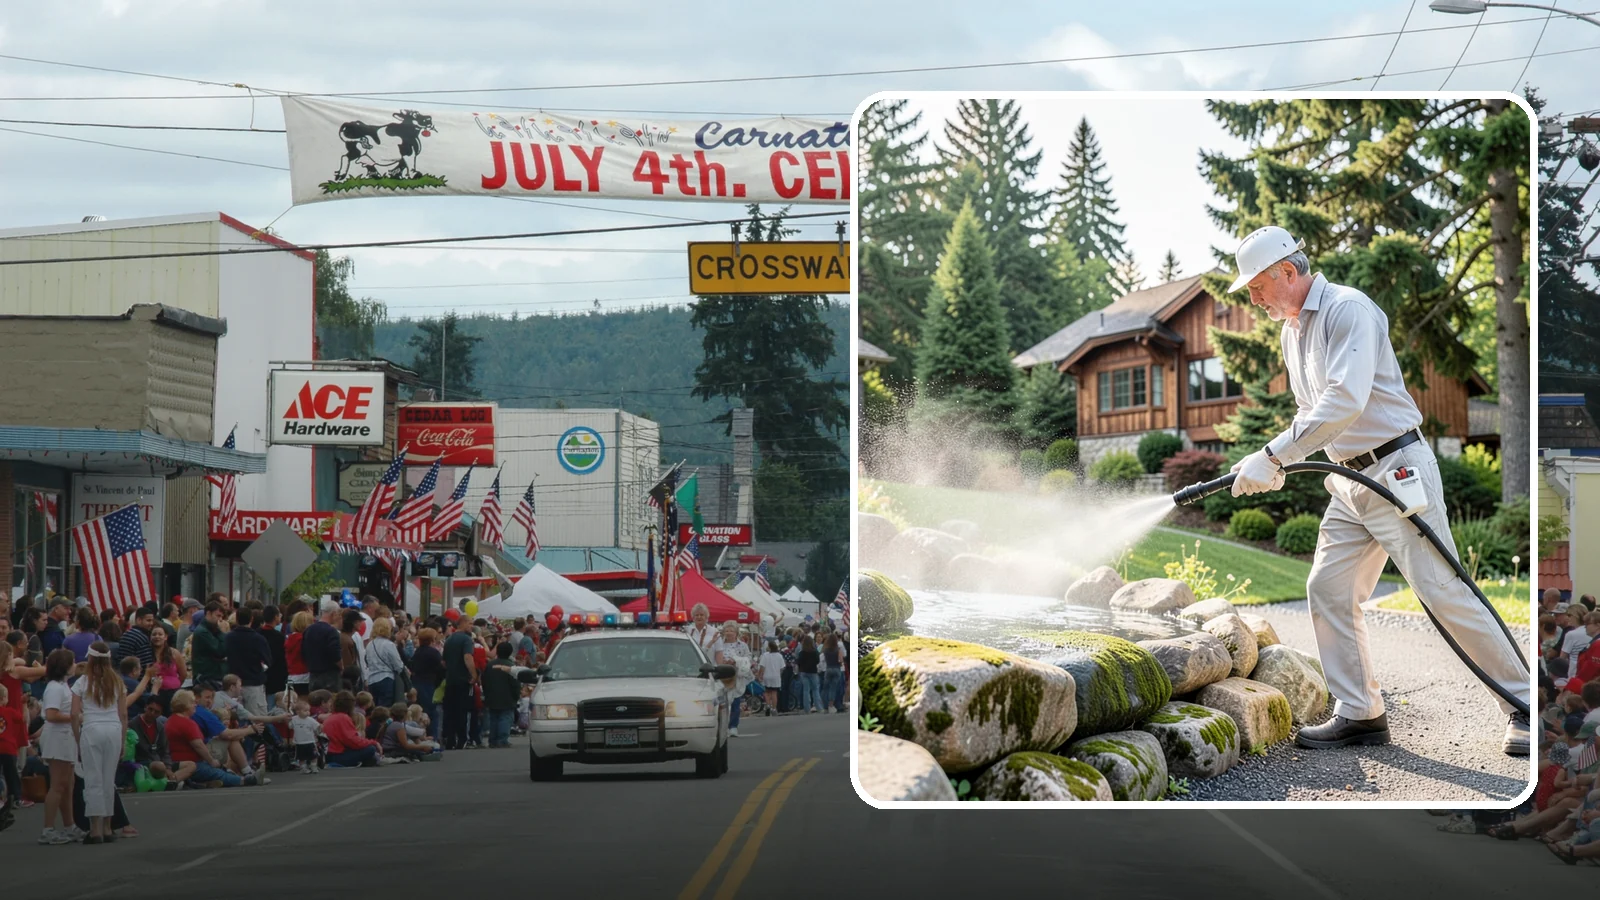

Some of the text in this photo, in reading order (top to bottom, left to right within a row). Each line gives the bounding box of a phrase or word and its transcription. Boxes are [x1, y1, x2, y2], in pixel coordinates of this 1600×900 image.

[481, 141, 605, 192] JULY
[632, 150, 746, 198] 4th.
[697, 254, 850, 280] CROSSWA
[283, 380, 374, 420] ACE
[406, 409, 486, 422] CEDAR LOG
[283, 421, 371, 436] Hardware
[416, 428, 477, 447] Coca-Cola
[353, 467, 385, 480] Simpl
[83, 485, 155, 495] St. Vincent de Paul
[688, 526, 741, 535] CRNATION
[699, 535, 730, 543] GLASS
